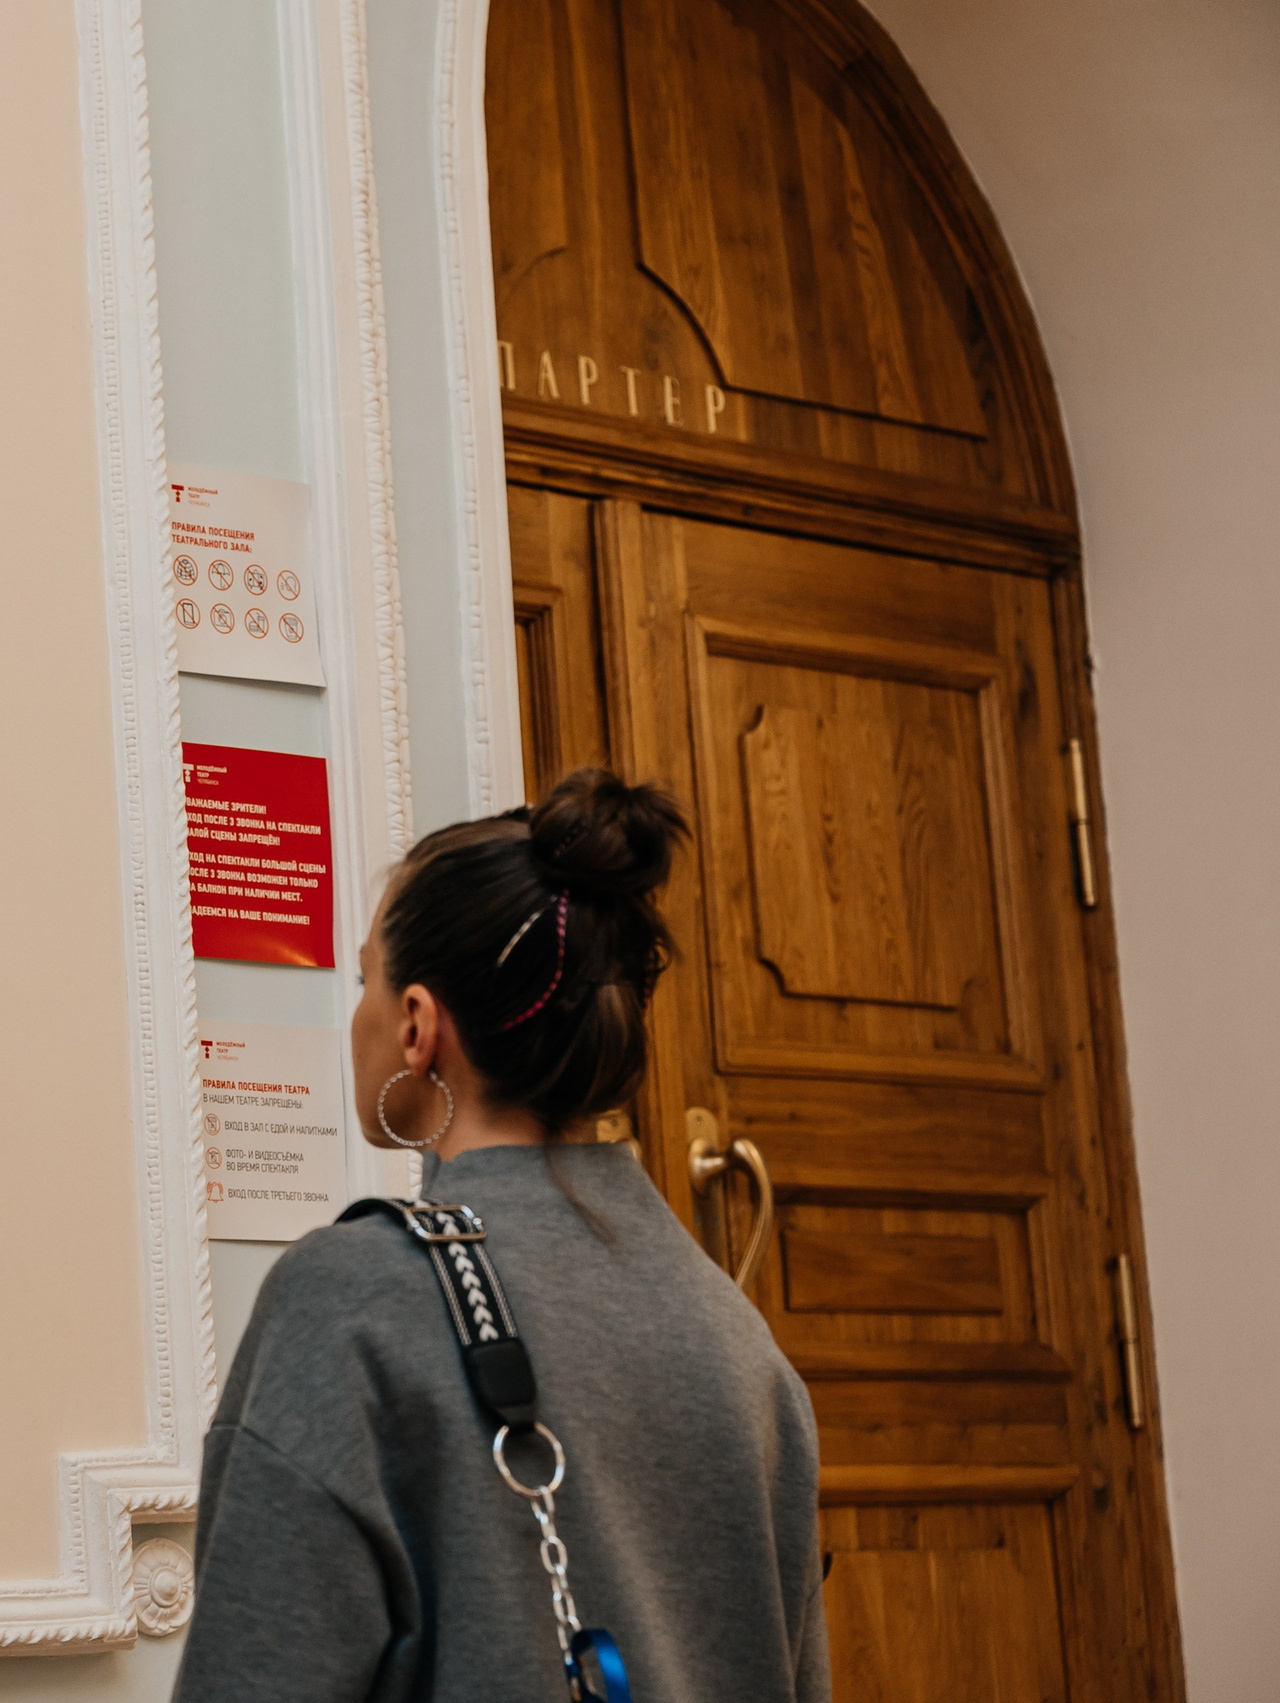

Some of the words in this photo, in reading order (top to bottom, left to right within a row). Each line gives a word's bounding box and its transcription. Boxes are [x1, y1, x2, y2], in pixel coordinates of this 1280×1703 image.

[498, 341, 726, 434] ПАРТЕР
[172, 522, 206, 534] ПРАВИЛА
[209, 526, 254, 541] ПОСЕЩЕНИЯ
[172, 535, 228, 550] ТЕАТРАЛЬНОГО
[230, 542, 252, 553] ЗАЛА:
[186, 797, 229, 810] ВАЖАЕМЫЕ
[231, 802, 266, 814] ЗРИТЕЛИ!
[188, 814, 202, 824] ХОД
[204, 816, 227, 826] ПОСЛЕ
[236, 818, 264, 829] ЗВОНКА
[266, 821, 276, 830] НА
[278, 822, 321, 834] СПЕКТАКЛИ
[188, 828, 209, 838] АЛОЙ
[211, 830, 237, 842] СЦЕНЫ
[239, 832, 280, 846] ЗАПРЕЩЁН!
[189, 853, 204, 863] ХОД
[206, 854, 216, 863] НА
[218, 855, 260, 867] СПЕКТАКЛИ
[262, 858, 297, 871] БОЛЬШОЙ
[298, 863, 326, 874] СЦЕНЫ
[217, 870, 245, 881] ЗВОНКА
[247, 873, 288, 885] ВОЗМОЖЕН
[289, 876, 318, 888] ТОЛЬКО
[198, 884, 226, 894] БАЛКОН
[228, 887, 243, 896] ПРИ
[245, 888, 280, 899] НАЛИЧИИ
[281, 891, 303, 902] МЕСТ.
[190, 906, 226, 917] АДЕЕМСЯ
[228, 909, 238, 918] НА
[240, 910, 261, 920] ВАШЕ
[263, 912, 310, 925] ПОНИМАНИЕ!
[203, 1079, 236, 1089] ПРАВИЛА
[238, 1082, 282, 1094] ПОСЕЩЕНИЯ
[284, 1085, 310, 1095] ТЕАТРА
[209, 1095, 235, 1104] НАШЕМ
[236, 1097, 259, 1106] ТЕАТРЕ
[225, 1121, 242, 1132] ВХОД
[244, 1122, 249, 1131] В
[250, 1123, 263, 1132] ЗАЛ
[265, 1124, 269, 1133] С
[271, 1123, 288, 1135] ЕДОЙ
[290, 1126, 295, 1134] И
[296, 1126, 337, 1136] НАПИТКАМИ
[226, 1151, 247, 1159] ФОТО-
[248, 1151, 253, 1159] И
[255, 1150, 304, 1162] ВИДЕОСЪЁМКА
[237, 1163, 260, 1171] ВРЕМЯ
[262, 1164, 299, 1173] СПЕКТАКЛЯ
[228, 1189, 246, 1199] ВХОД
[248, 1190, 269, 1199] ПОСЛЕ
[271, 1191, 302, 1201] ТРЕТЬЕГО
[303, 1193, 329, 1202] ЗВОНКА
